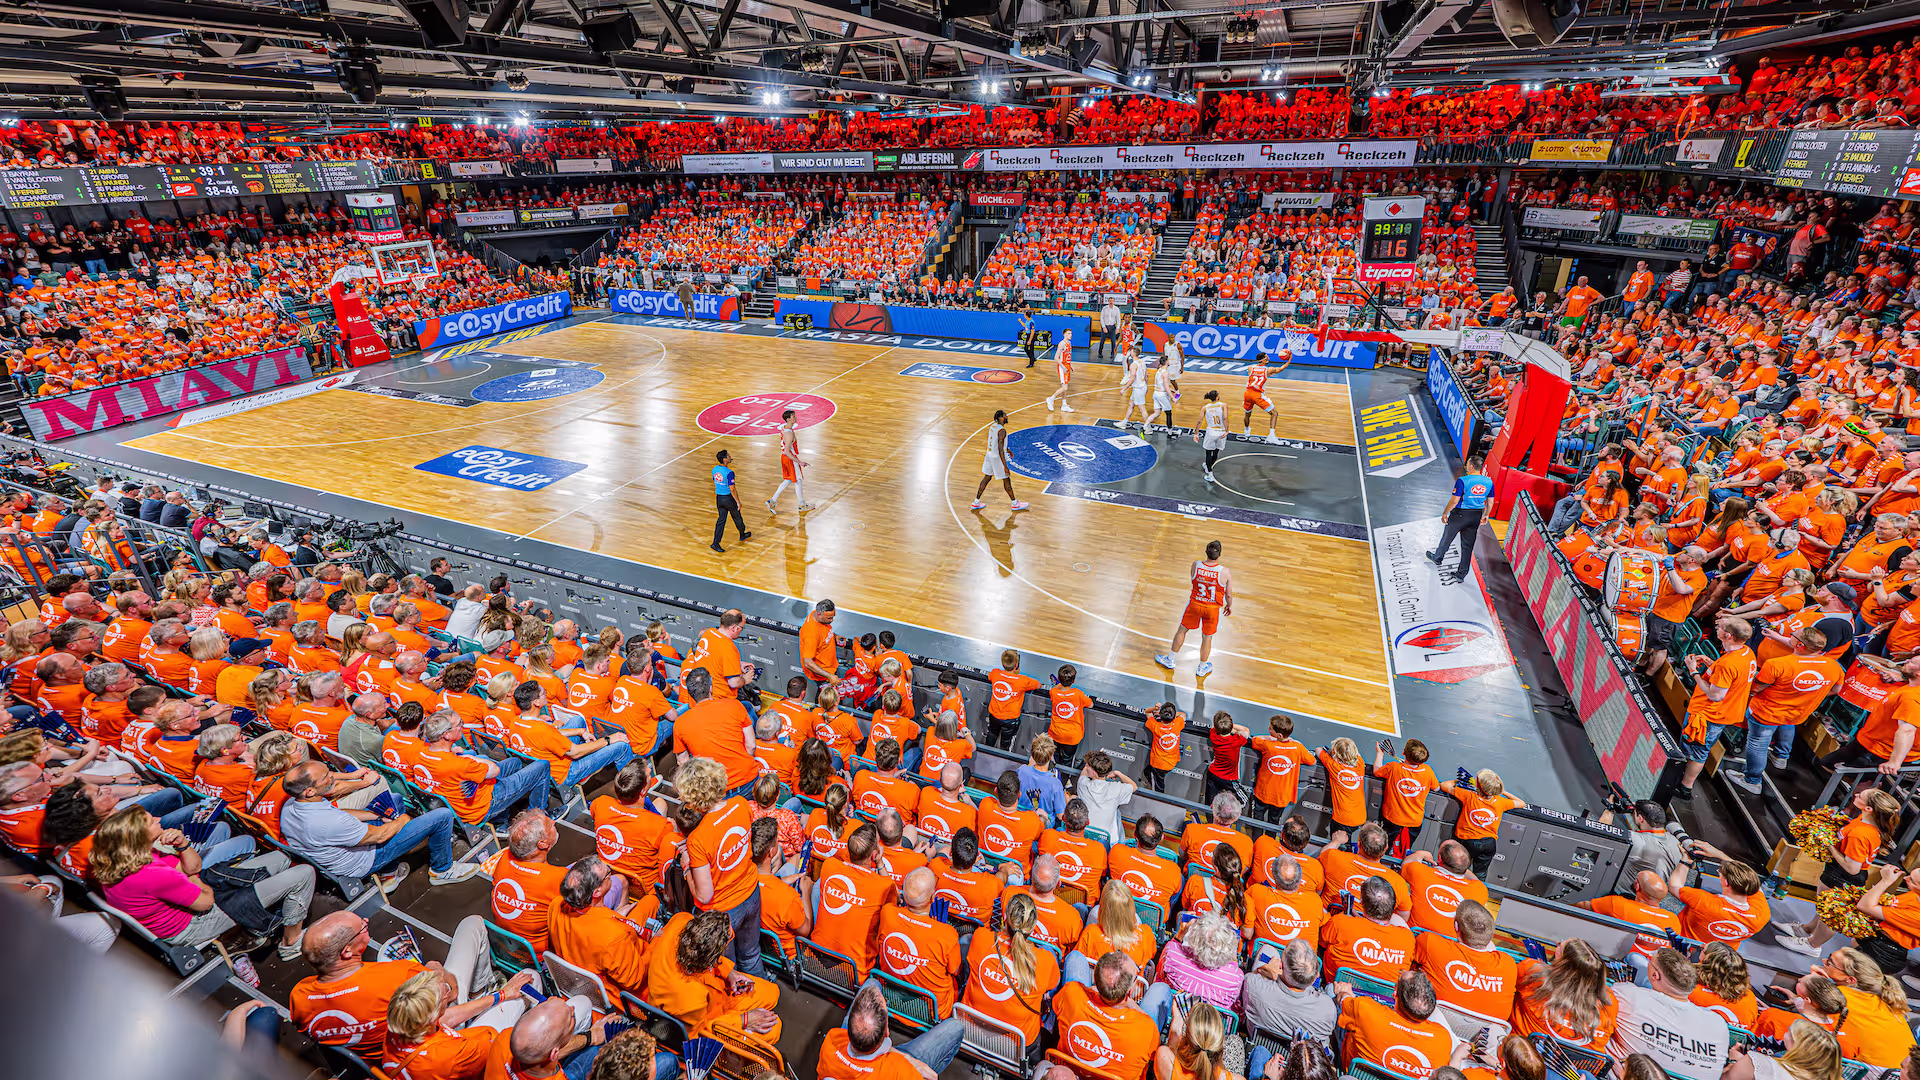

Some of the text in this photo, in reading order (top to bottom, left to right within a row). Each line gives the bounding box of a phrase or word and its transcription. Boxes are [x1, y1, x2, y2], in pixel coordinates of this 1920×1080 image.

[1844, 132, 1849, 141] 0
[1840, 142, 1845, 150] 0
[1846, 142, 1880, 152] 22 GROVES
[1911, 144, 1918, 152] 2
[901, 152, 954, 164] ABLIEFERN!
[997, 156, 1041, 164] Reckzeh
[1056, 155, 1104, 164] Reckzeh
[1124, 154, 1174, 163] Reckzeh
[1192, 152, 1244, 162] Reckzeh
[1268, 152, 1325, 161] Reckzeh
[1346, 151, 1406, 160] Reckzeh
[1836, 152, 1841, 160] 0
[1906, 154, 1912, 164] 0
[254, 164, 260, 172] 3
[781, 158, 796, 168] WIR
[797, 158, 814, 168] SIND
[816, 158, 832, 167] GUT
[834, 158, 843, 167] IM
[1831, 162, 1838, 170] 2
[166, 167, 174, 175] 2
[1890, 166, 1898, 174] 2
[1902, 166, 1908, 176] 0
[1842, 173, 1865, 183] REAVES
[1894, 177, 1903, 186] 11
[204, 186, 239, 196] 38-46
[1824, 182, 1830, 190] 0
[1883, 188, 1888, 196] 1
[377, 233, 402, 242] tipico
[1365, 266, 1412, 280] tipico
[618, 290, 718, 318] e@syCrdit
[440, 324, 549, 359] EWE EWE
[794, 330, 1028, 356] RASTA DOME
[362, 346, 376, 354] LzO
[908, 368, 956, 379] BBL
[28, 347, 305, 441] MIAVI
[188, 388, 314, 424] Transport Logistik GmbH
[1212, 415, 1220, 425] 10
[1360, 400, 1412, 433] EWE
[1366, 428, 1424, 468] EWE
[1032, 442, 1078, 470] HYUNDAI
[457, 465, 553, 489] Credit
[1198, 568, 1218, 578] REAVES
[1386, 529, 1425, 624] Transport Logistik GmbH
[1198, 584, 1216, 602] 31
[1790, 620, 1804, 632] 12
[1798, 679, 1831, 687] MIAVIT
[570, 691, 598, 701] MIAVIT
[993, 688, 1018, 696] MIAVIT
[1271, 761, 1298, 770] MIAVIT
[1341, 774, 1364, 782] MIAVIT
[1401, 784, 1426, 793] MIAVIT
[1472, 813, 1500, 822] MIAVIT
[598, 836, 634, 854] MIAVIT
[814, 836, 848, 849] MIAVIT
[988, 836, 1022, 848] MIAVIT
[1058, 863, 1092, 874] MIAVIT
[1126, 880, 1162, 898] MIAVIT
[826, 886, 866, 906] MIAVIT
[497, 892, 537, 912] MIAVIT
[1270, 916, 1310, 928] MIAVIT
[1638, 932, 1670, 947] MIAVI
[887, 946, 929, 967] MIAVIT
[1362, 946, 1405, 964] MIAVIT
[1454, 969, 1503, 992] MIAVIT
[316, 1020, 377, 1038] MIAVIT
[1640, 1034, 1655, 1045] FOR
[1656, 1038, 1690, 1054] PRIVATE
[1641, 1022, 1717, 1058] OFFLINE
[1073, 1035, 1124, 1062] MIAVIT
[1390, 1057, 1434, 1078] MIAVI
